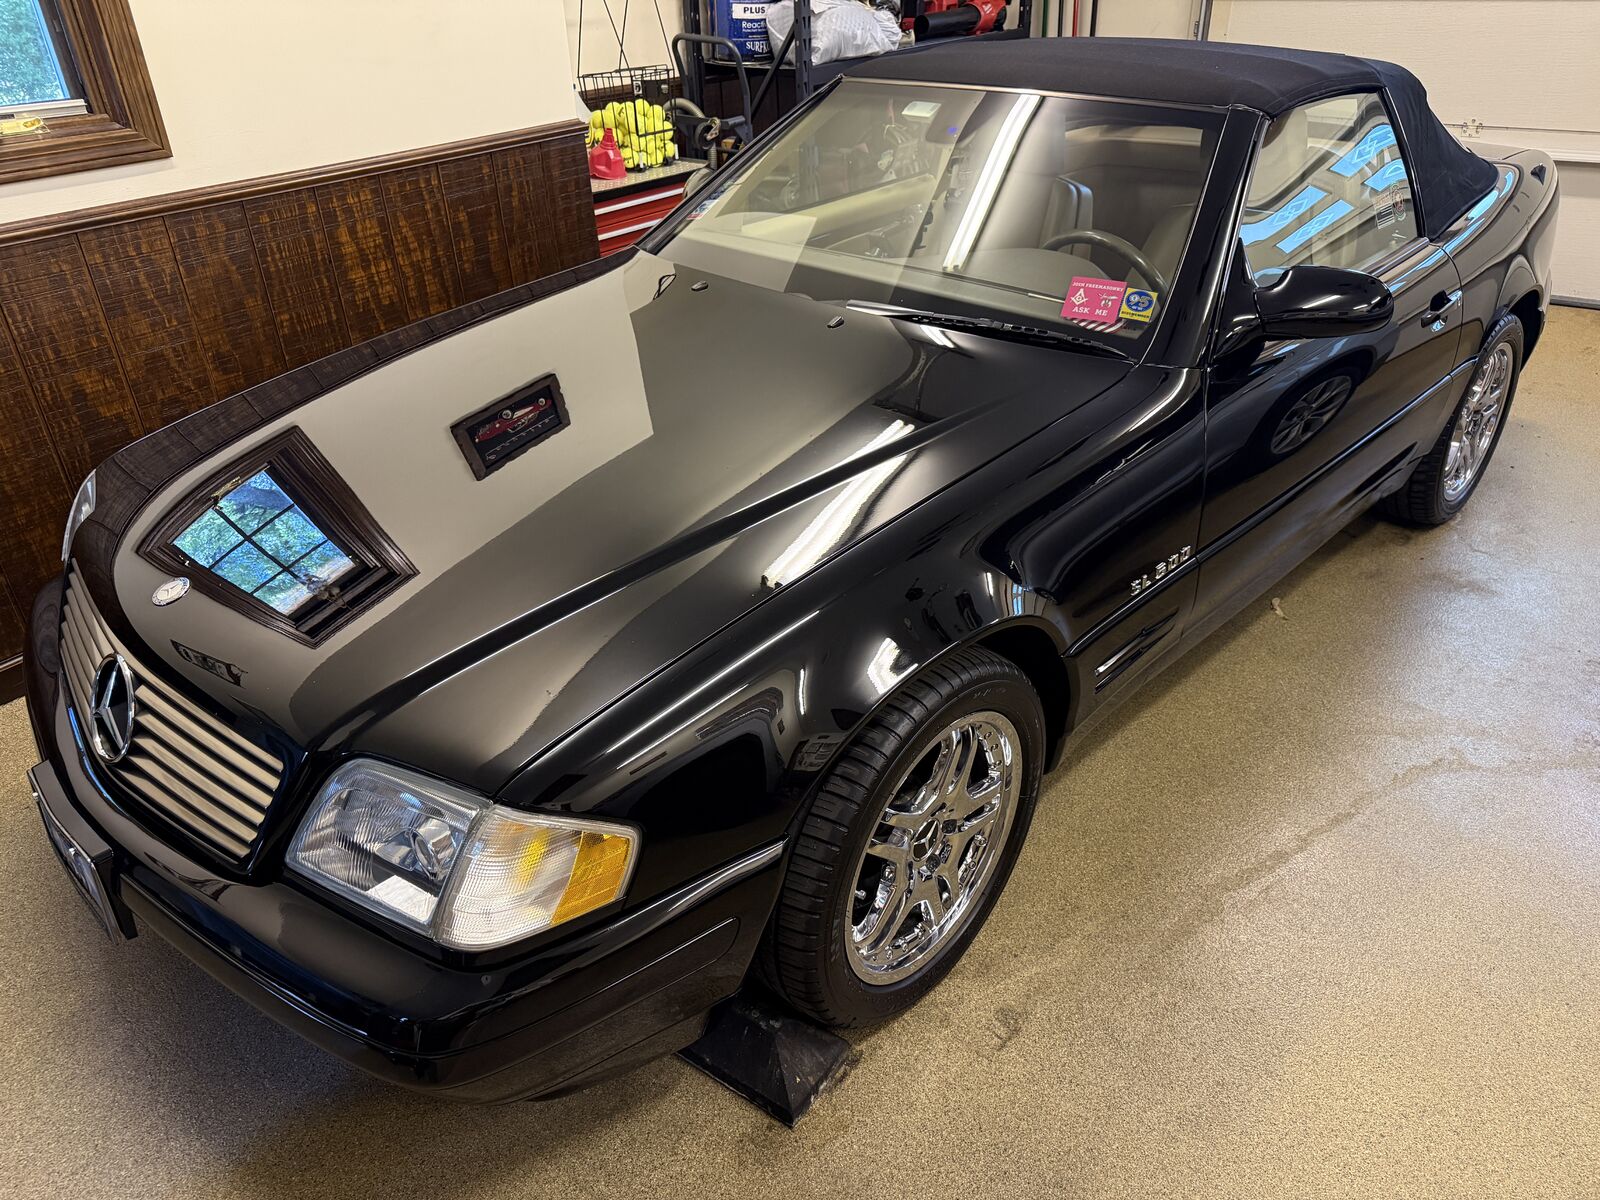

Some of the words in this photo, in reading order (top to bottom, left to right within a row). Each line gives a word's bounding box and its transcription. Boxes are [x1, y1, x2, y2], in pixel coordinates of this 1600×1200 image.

[743, 6, 766, 14] PLUS
[1086, 283, 1124, 291] FREEMASONRY
[1072, 306, 1090, 314] ASK
